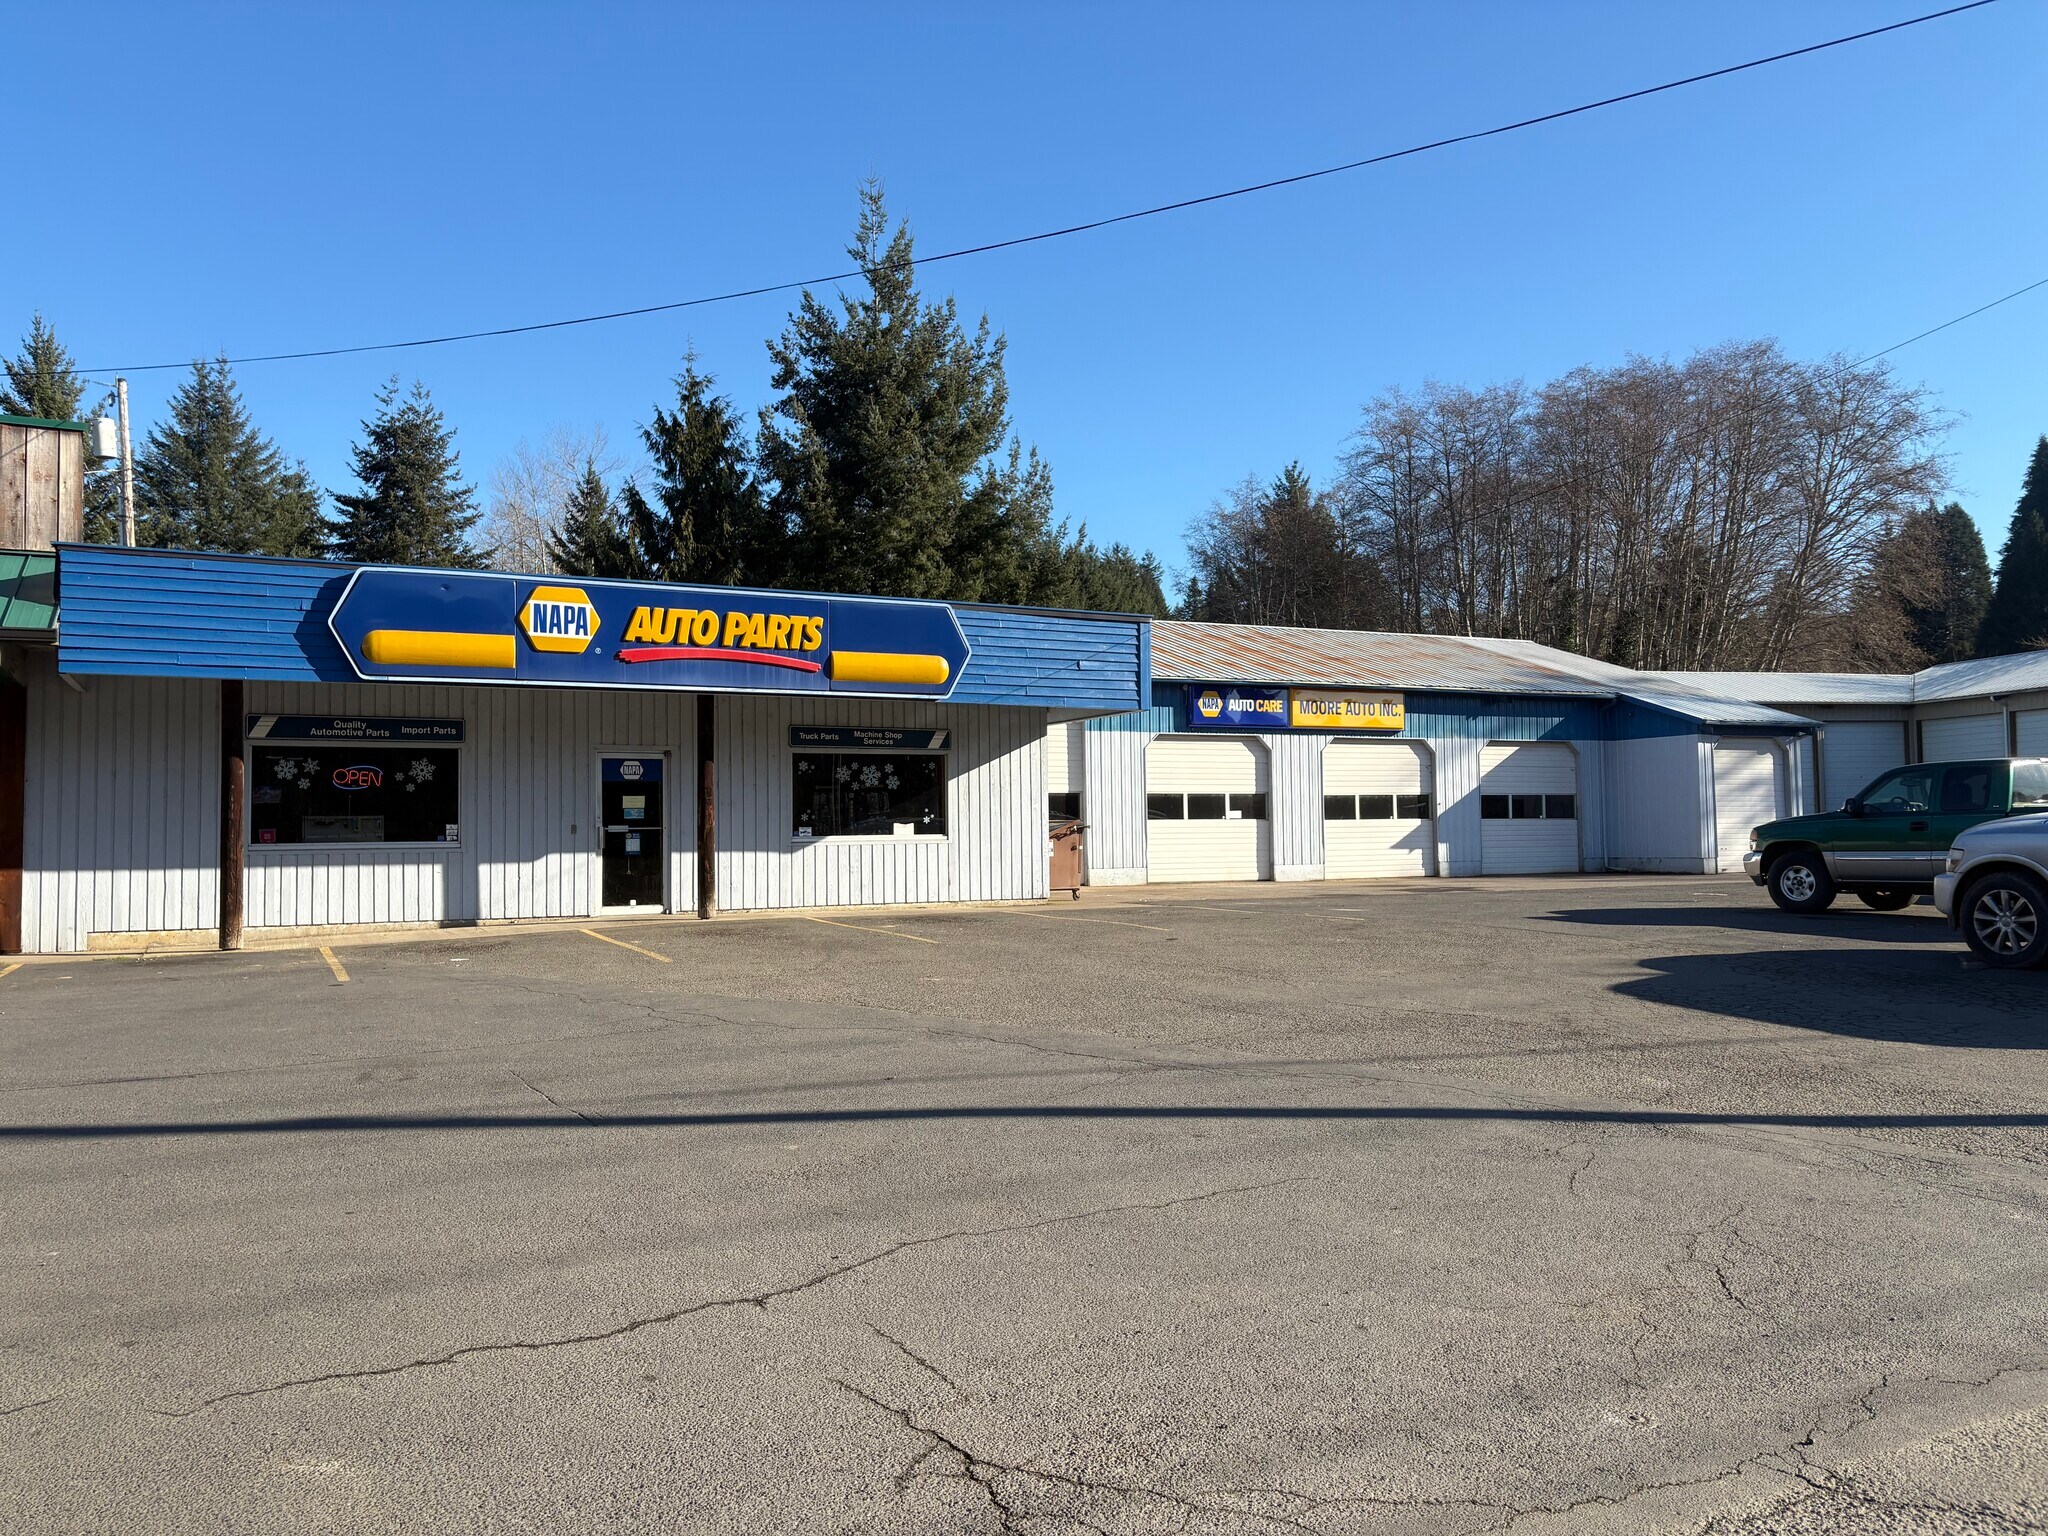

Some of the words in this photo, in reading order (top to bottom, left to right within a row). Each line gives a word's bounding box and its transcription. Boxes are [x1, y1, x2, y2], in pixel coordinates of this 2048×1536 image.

[533, 603, 589, 637] NAPA
[624, 606, 721, 647] AUTO
[722, 611, 824, 652] PARTS
[1202, 700, 1220, 710] NAPA
[1228, 699, 1254, 712] AUTO
[1256, 699, 1283, 713] CARE
[1299, 700, 1342, 715] MOORE
[1345, 702, 1377, 716] AUTO
[1379, 703, 1402, 717] INC.
[334, 720, 367, 730] Quality
[310, 728, 364, 737] Automotive
[366, 728, 390, 737] Parts
[401, 726, 431, 735] Import
[433, 726, 457, 735] Parts
[884, 731, 903, 740] Shop
[799, 732, 819, 740] Truck
[820, 733, 839, 741] Parts
[623, 765, 640, 775] NAPA
[333, 768, 382, 787] OPEN
